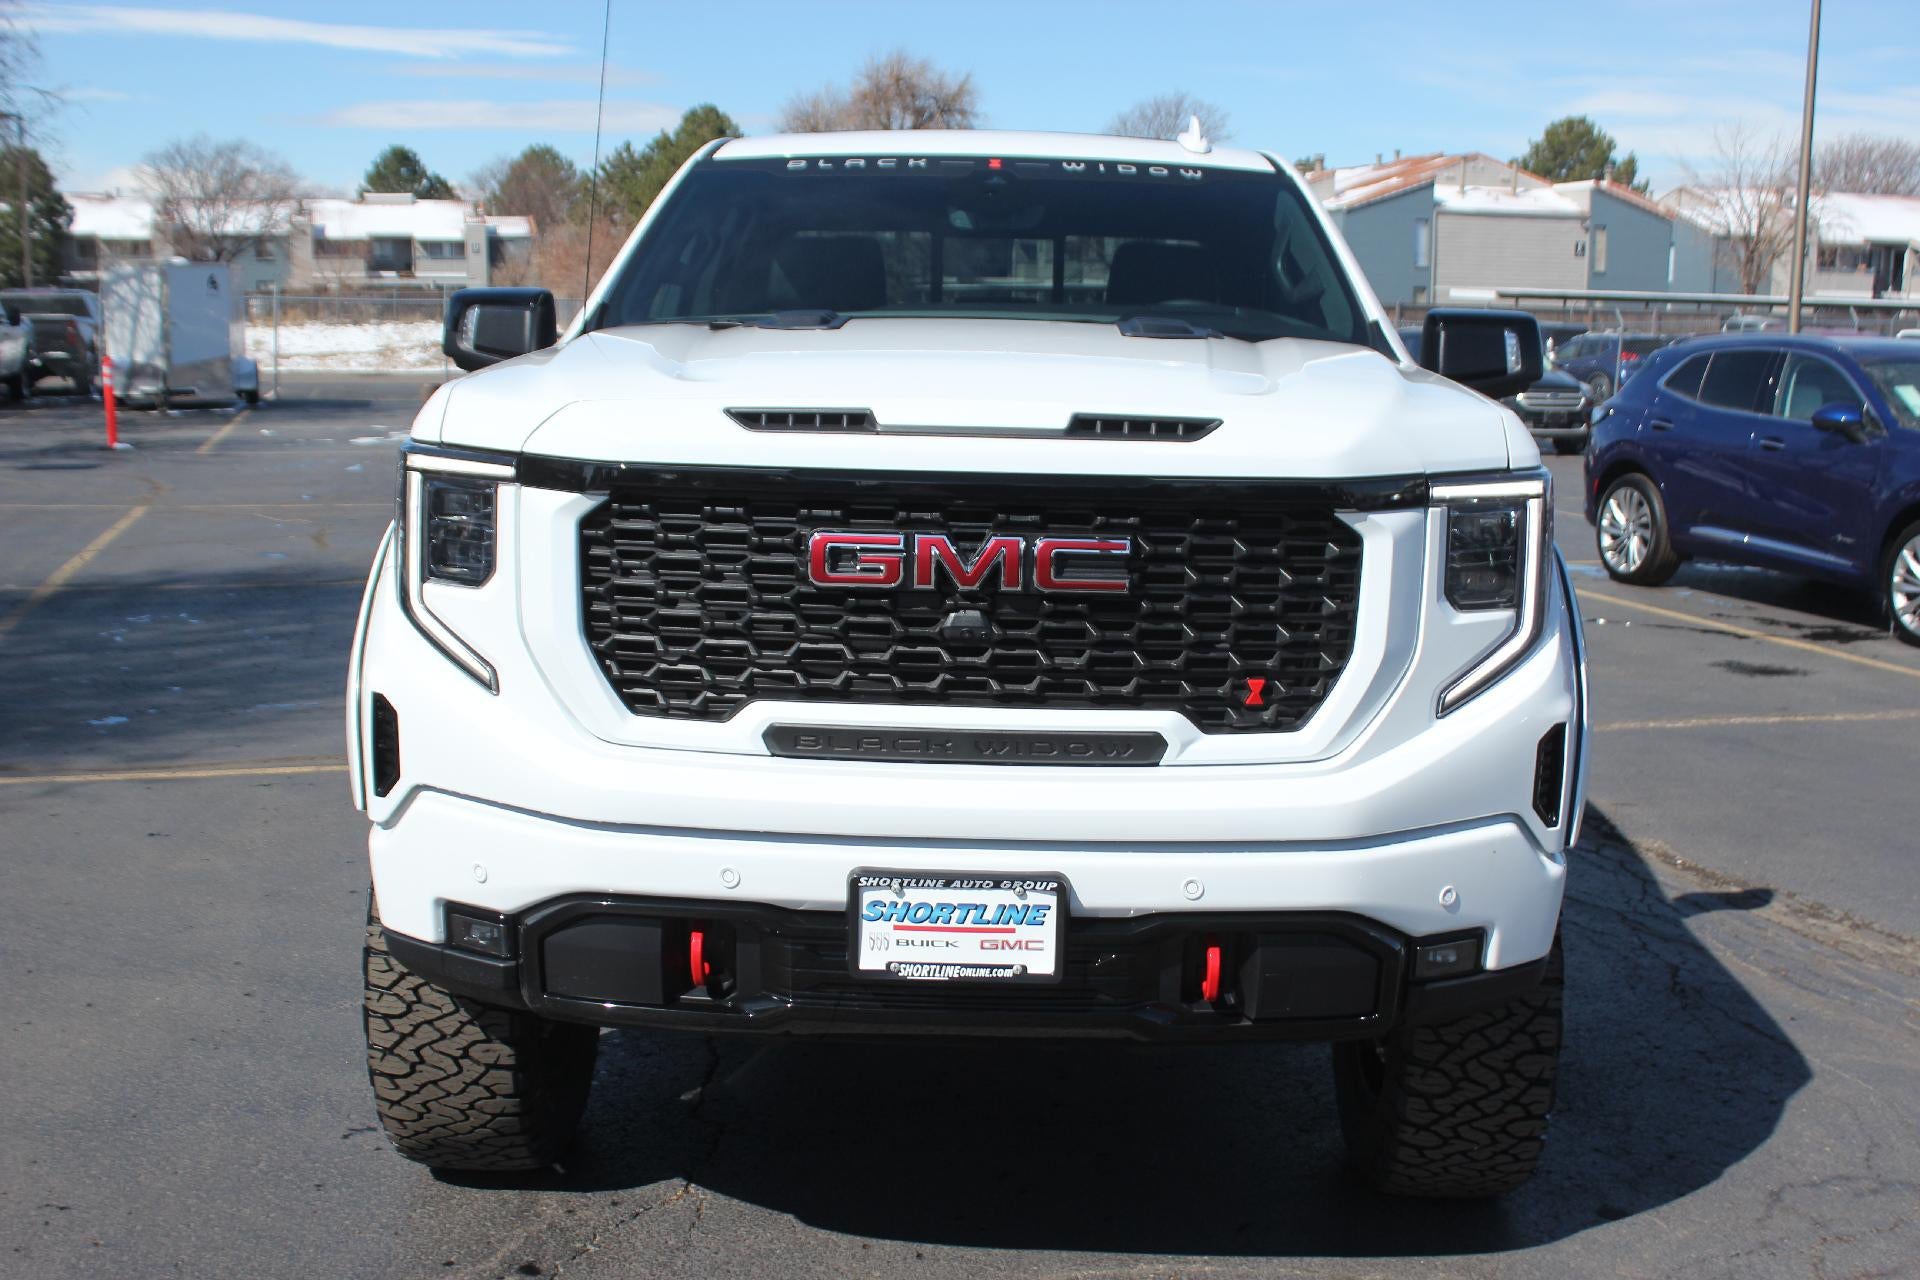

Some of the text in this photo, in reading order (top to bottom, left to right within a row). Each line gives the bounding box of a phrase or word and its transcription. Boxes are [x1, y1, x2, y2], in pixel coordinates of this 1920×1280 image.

[786, 157, 1203, 179] BLACK WIDOW
[807, 530, 1132, 593] GMC
[794, 734, 1134, 758] BLACK WIDOW
[857, 876, 1058, 891] SHORTLINE AUTO GROUP
[861, 899, 1052, 926] SHORTLINE
[896, 938, 959, 948] BUICK
[979, 938, 1045, 951] GMC
